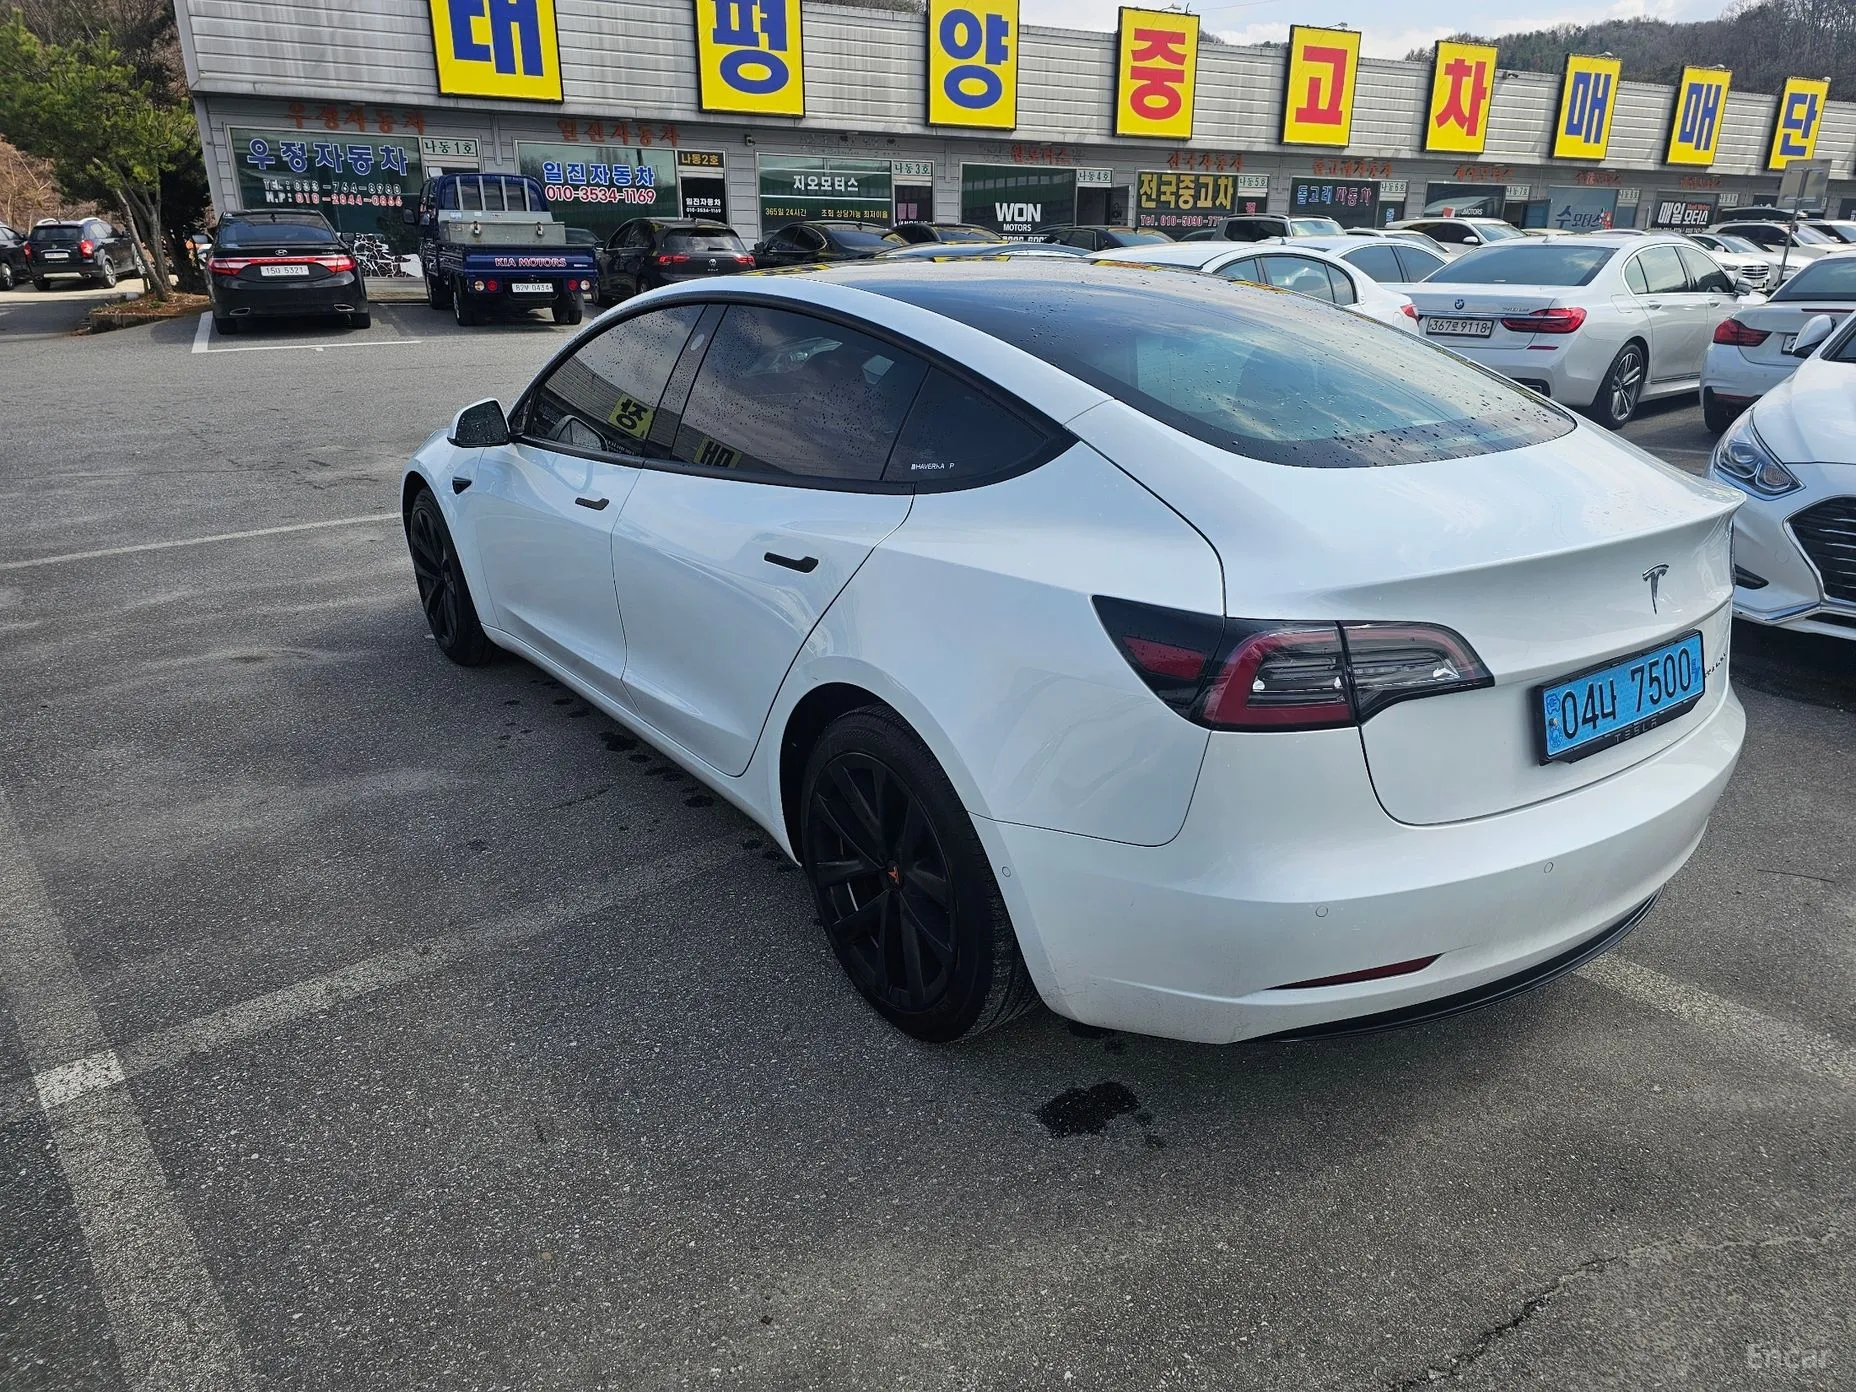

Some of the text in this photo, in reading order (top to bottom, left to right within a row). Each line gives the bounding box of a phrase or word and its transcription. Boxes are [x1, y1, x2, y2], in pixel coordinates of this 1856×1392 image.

[247, 138, 408, 176] 우정자동차
[543, 161, 654, 187] 일진자동차
[793, 175, 859, 192] 지오모터스
[545, 184, 656, 205] 010-3534-1169
[685, 197, 721, 206] 일진자동차
[1140, 174, 1233, 209] 전국중고차
[765, 207, 784, 216] 365일
[785, 208, 807, 217] 24시간
[995, 202, 1041, 222] WON
[1003, 223, 1032, 232] MOTORS
[495, 257, 567, 267] KIA MOTORS
[1561, 678, 1616, 740] 04나
[1630, 647, 1691, 712] 7500
[1614, 717, 1658, 743] TESLA
